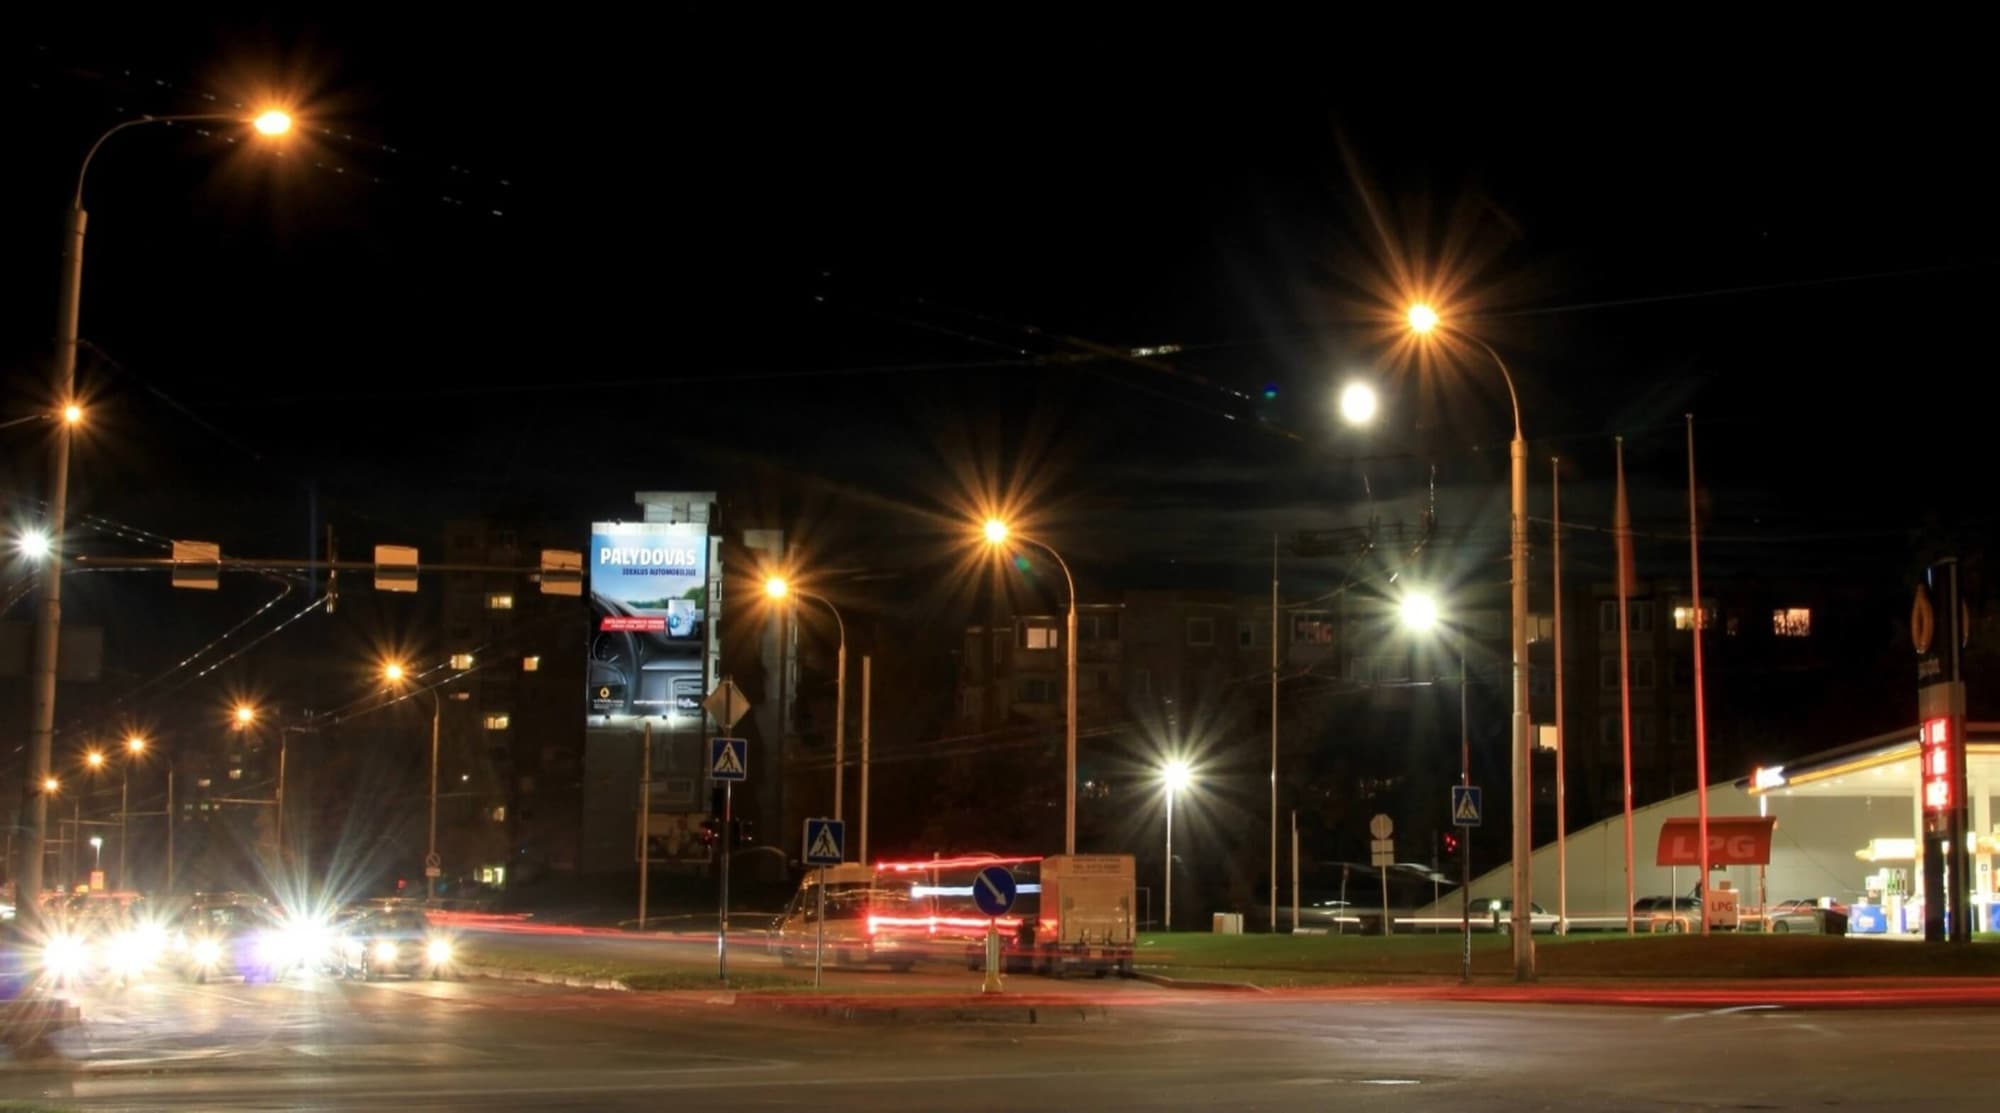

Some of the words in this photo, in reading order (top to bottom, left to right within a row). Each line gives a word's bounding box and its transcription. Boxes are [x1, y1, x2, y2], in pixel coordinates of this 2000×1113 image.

[600, 547, 696, 566] PALYDOVAS
[1672, 835, 1755, 859] LPG
[1711, 901, 1733, 912] LPG
